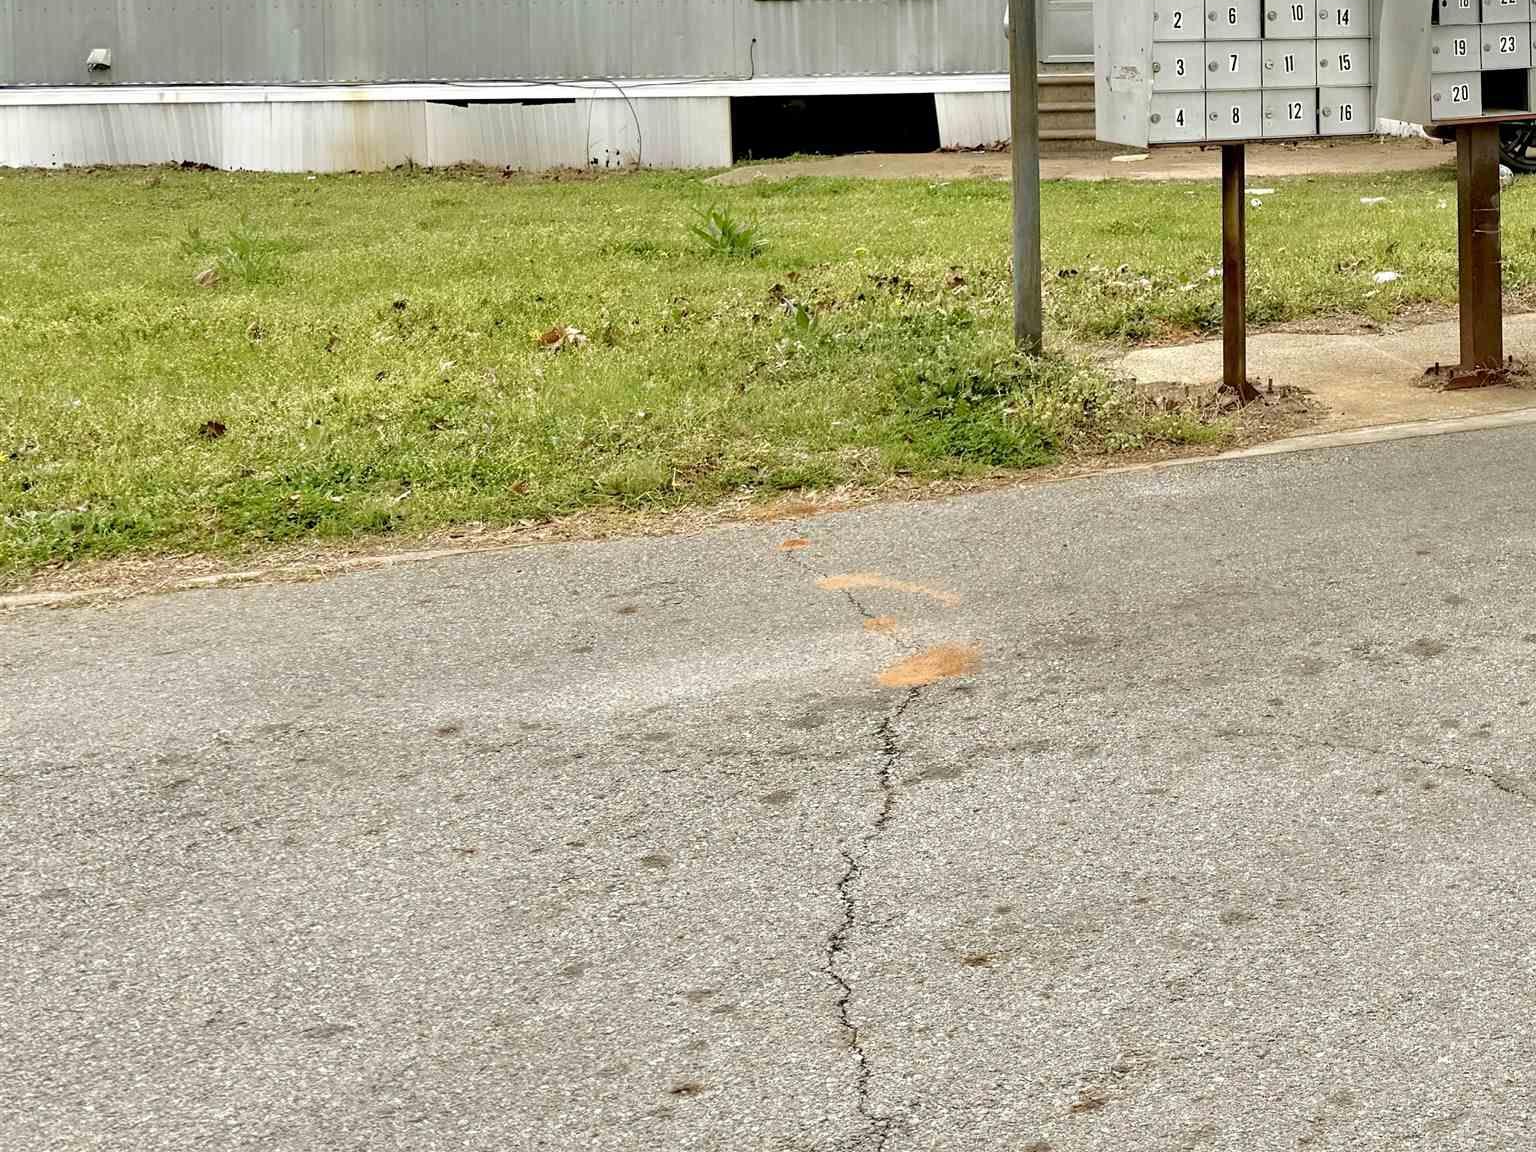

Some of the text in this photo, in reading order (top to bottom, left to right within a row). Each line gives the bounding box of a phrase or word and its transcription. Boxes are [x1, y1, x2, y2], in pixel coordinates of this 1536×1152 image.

[1173, 11, 1182, 29] 2
[1228, 7, 1236, 24] 6
[1291, 4, 1304, 21] 10
[1337, 9, 1349, 25] 14
[1454, 39, 1466, 56] 19
[1500, 36, 1515, 53] 23
[1176, 58, 1185, 76] 3
[1230, 54, 1238, 72] 7
[1284, 55, 1294, 73] 11
[1338, 54, 1351, 71] 15
[1452, 85, 1469, 102] 20
[1176, 109, 1184, 126] 4
[1232, 107, 1240, 124] 8
[1288, 102, 1302, 120] 12
[1340, 104, 1352, 122] 16
